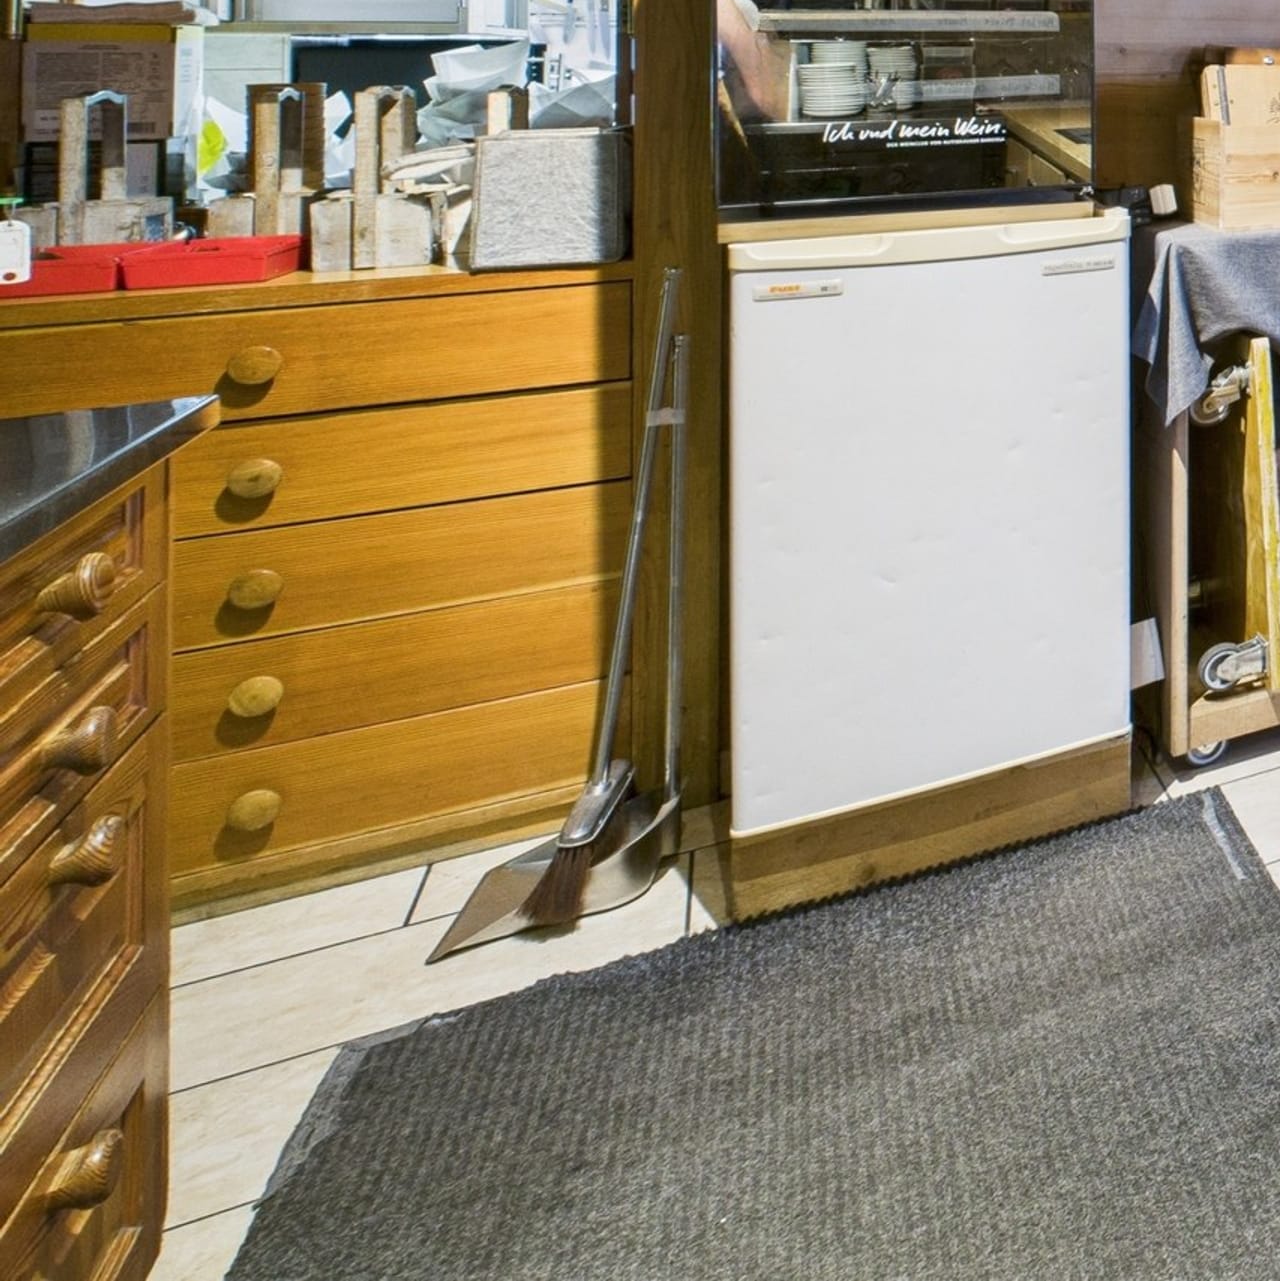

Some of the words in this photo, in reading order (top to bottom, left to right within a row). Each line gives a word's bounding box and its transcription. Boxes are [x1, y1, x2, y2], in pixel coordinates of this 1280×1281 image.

[823, 122, 855, 143] Ich
[859, 120, 898, 140] und
[899, 122, 950, 139] mein
[954, 116, 1007, 137] Wein.
